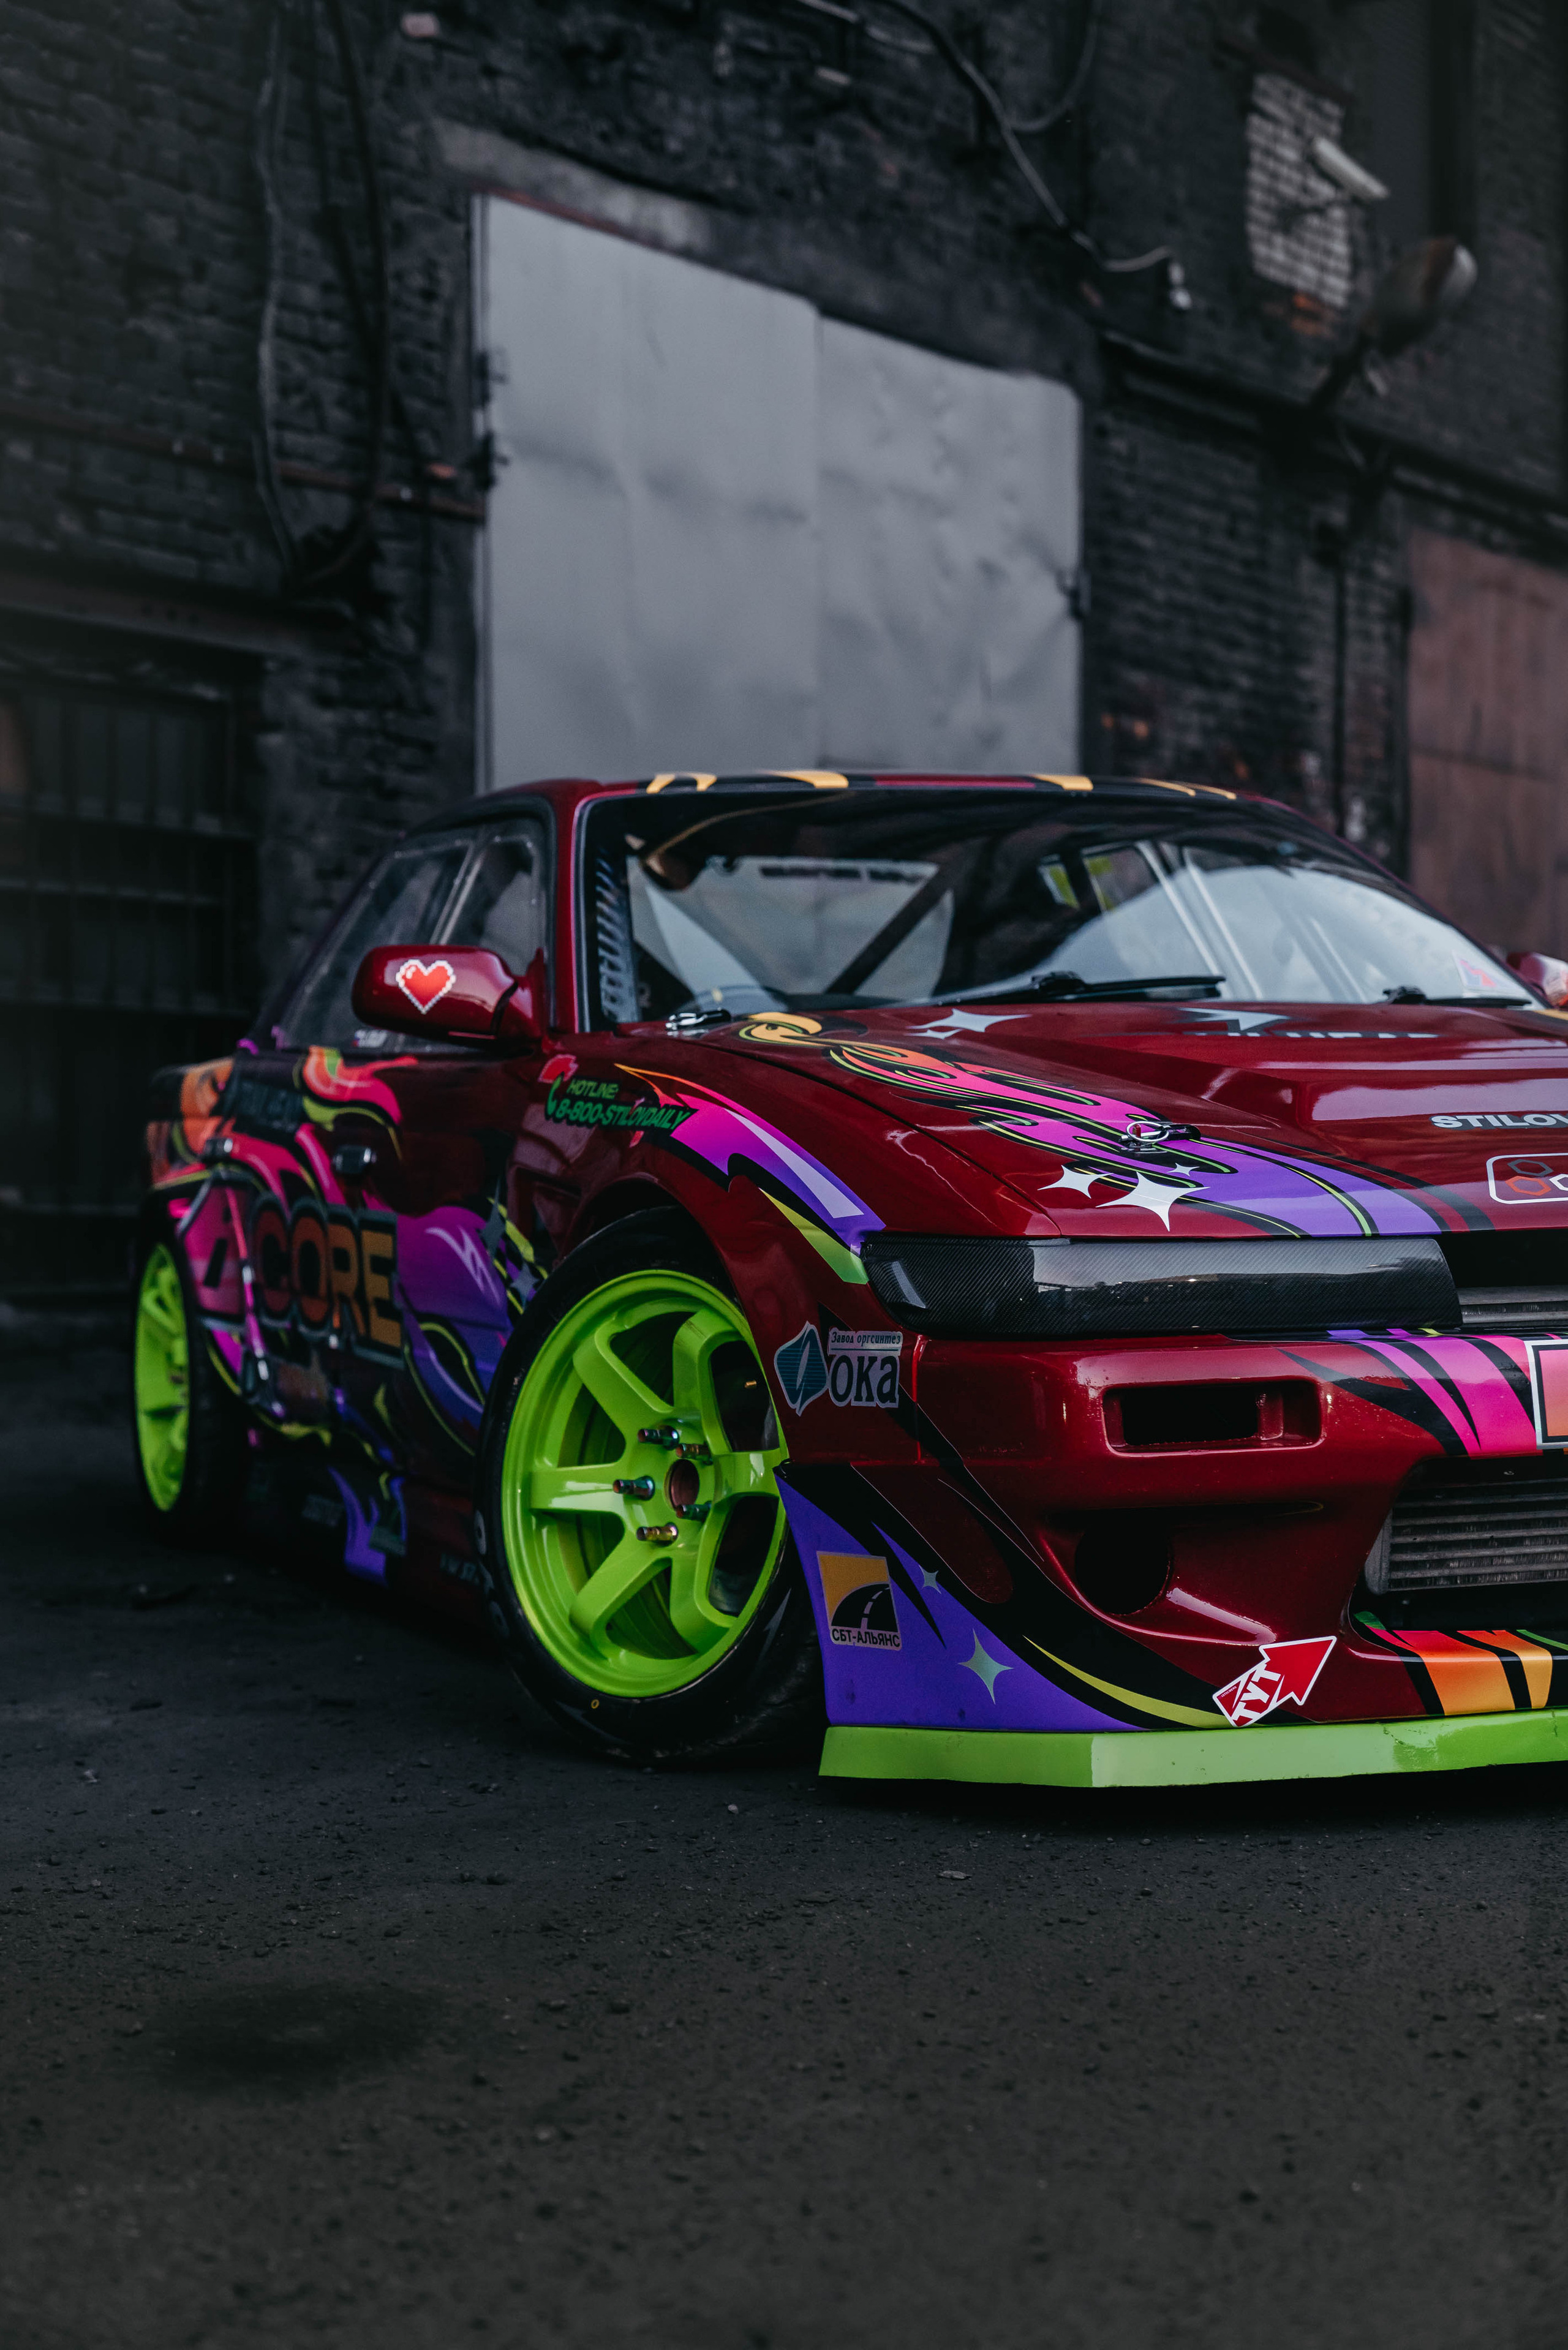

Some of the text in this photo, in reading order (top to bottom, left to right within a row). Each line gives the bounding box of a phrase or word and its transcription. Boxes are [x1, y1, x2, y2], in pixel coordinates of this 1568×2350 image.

[831, 1331, 901, 1346] Завод оргсинтез
[832, 1628, 900, 1648] СБТ-АЛЬЯНС
